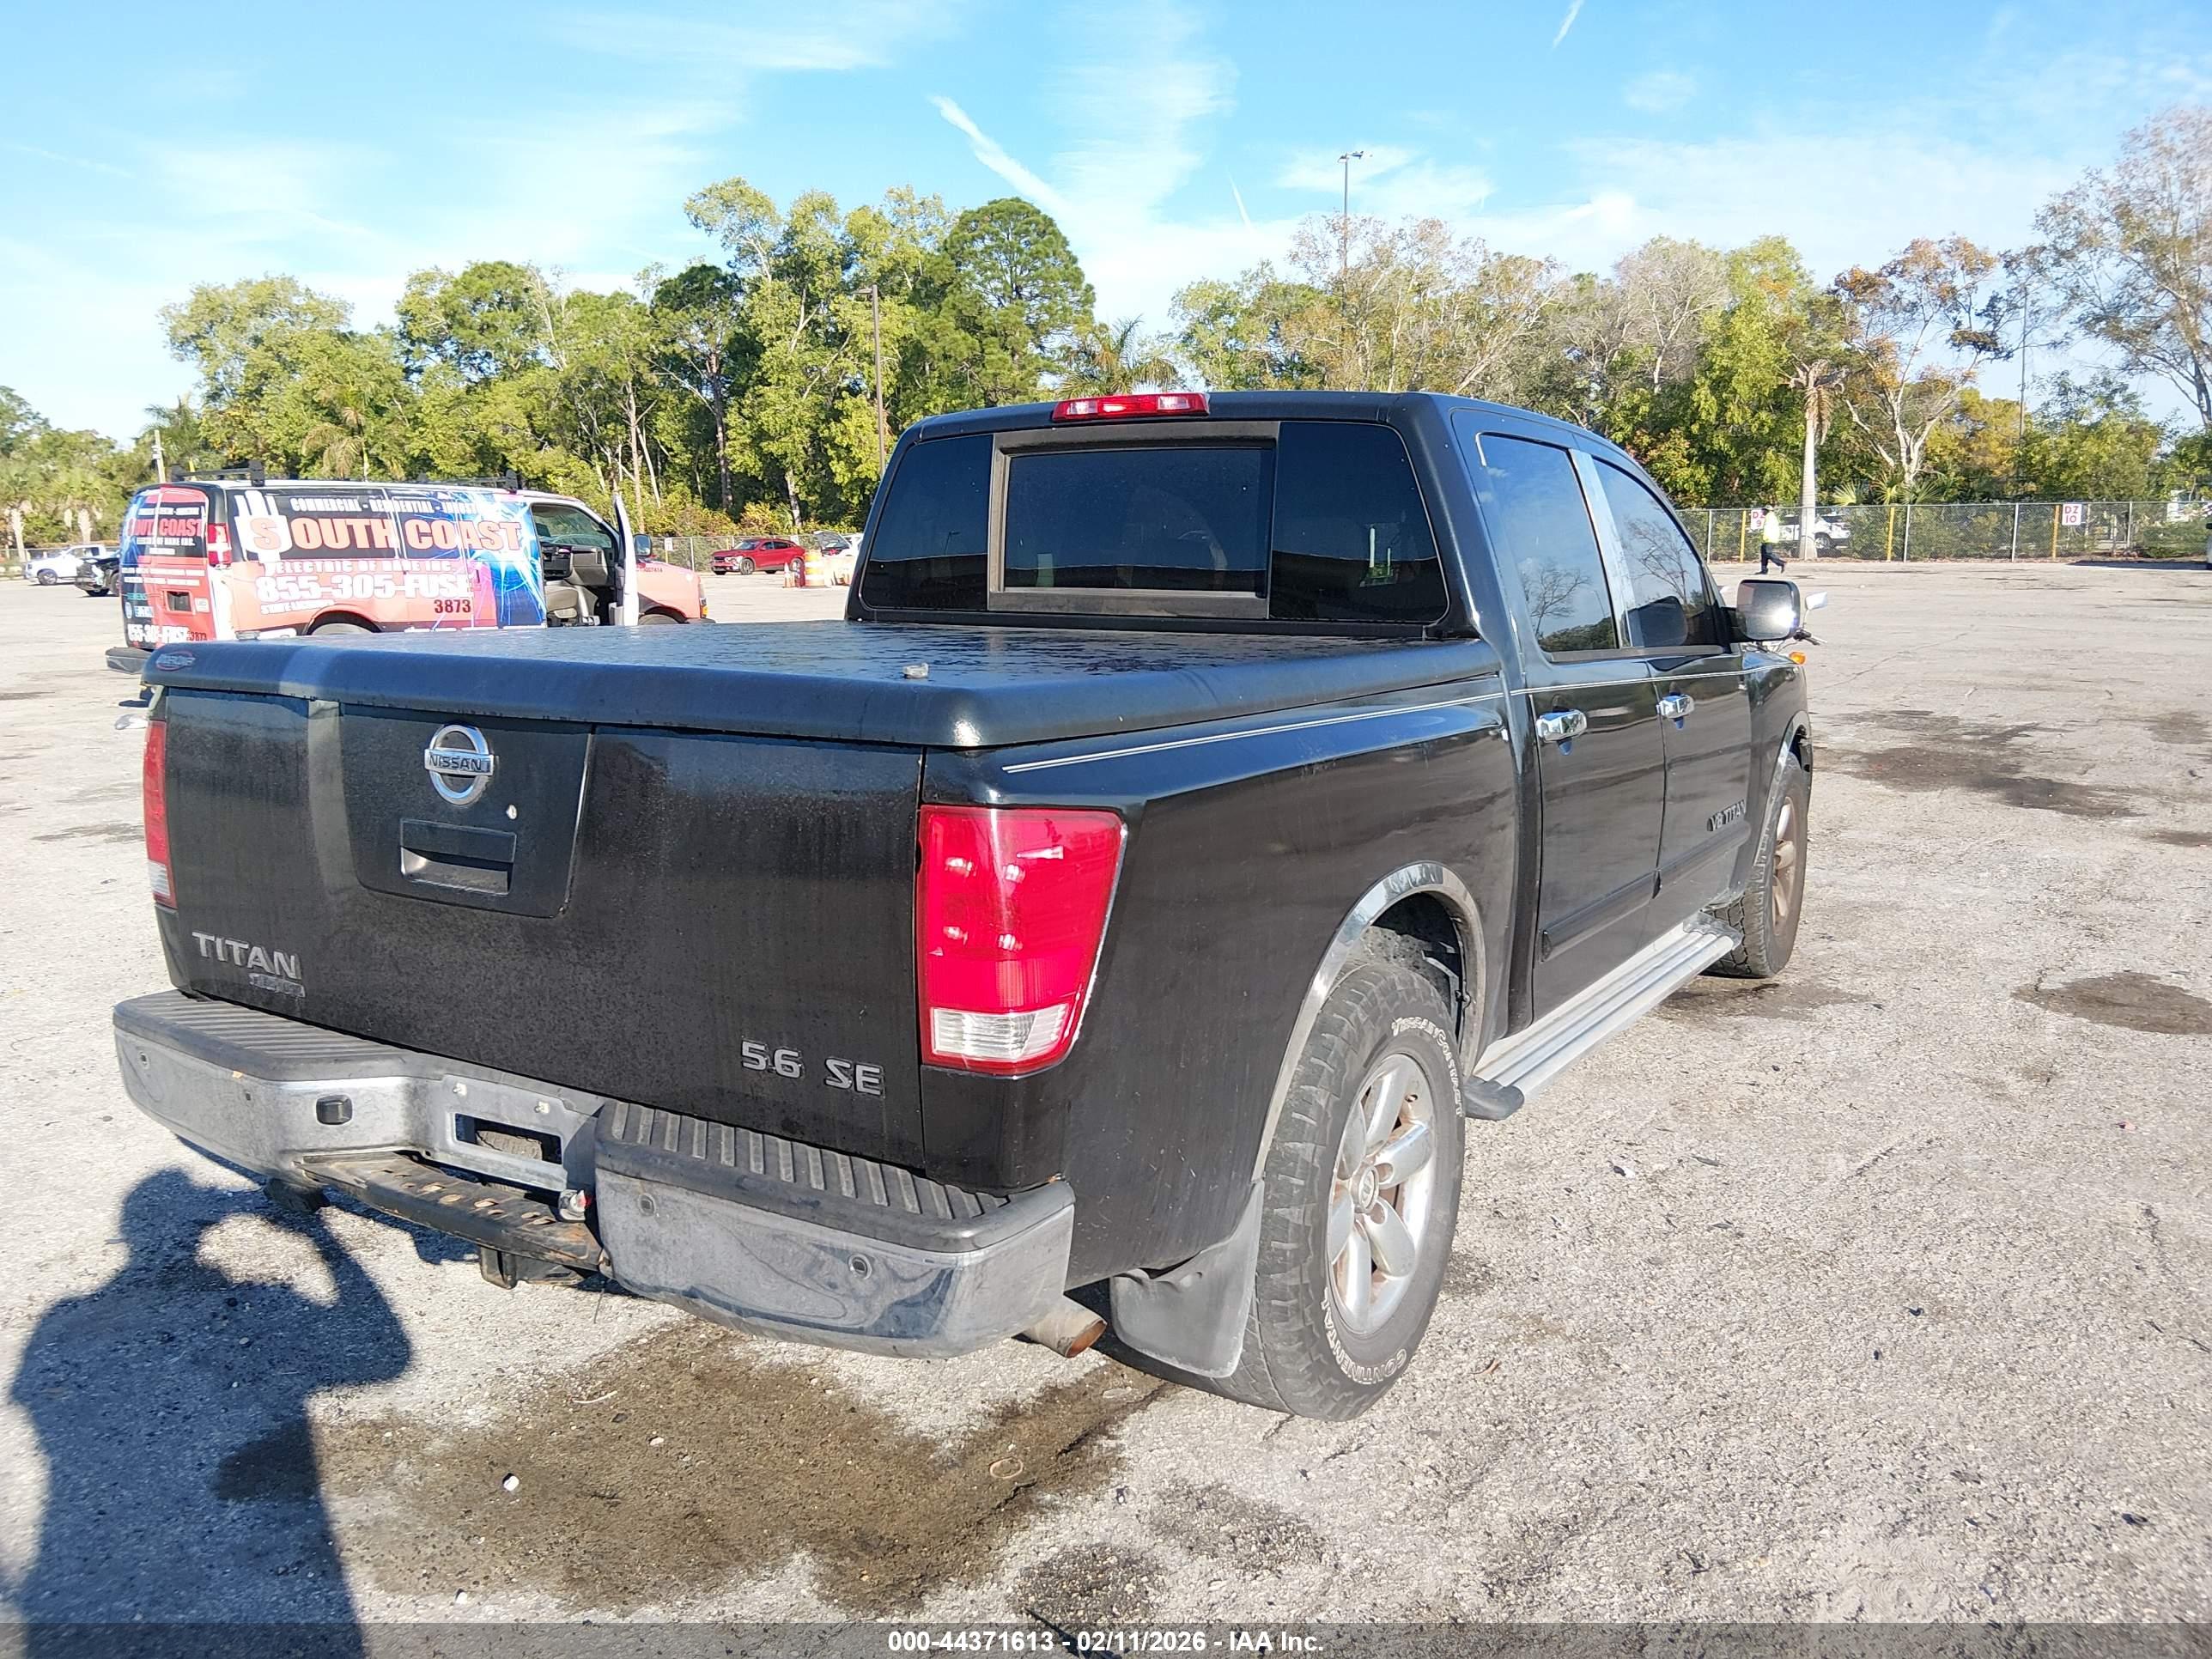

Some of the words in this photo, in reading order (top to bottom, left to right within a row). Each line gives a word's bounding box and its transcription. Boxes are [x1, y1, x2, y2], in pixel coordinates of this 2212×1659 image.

[2064, 505, 2079, 514] DZ
[158, 518, 203, 538] COAST
[250, 517, 399, 550] SOUTH
[404, 519, 522, 550] COAST
[276, 561, 353, 574] ELECTRIC
[256, 573, 471, 602] 855-305-FUSE
[434, 599, 471, 614] 3873
[429, 755, 482, 771] NISSAN
[191, 931, 301, 980] TITAN
[741, 1039, 803, 1079] 5.6
[824, 1057, 883, 1097] SE
[1321, 1286, 1407, 1385] CONTINENTAL
